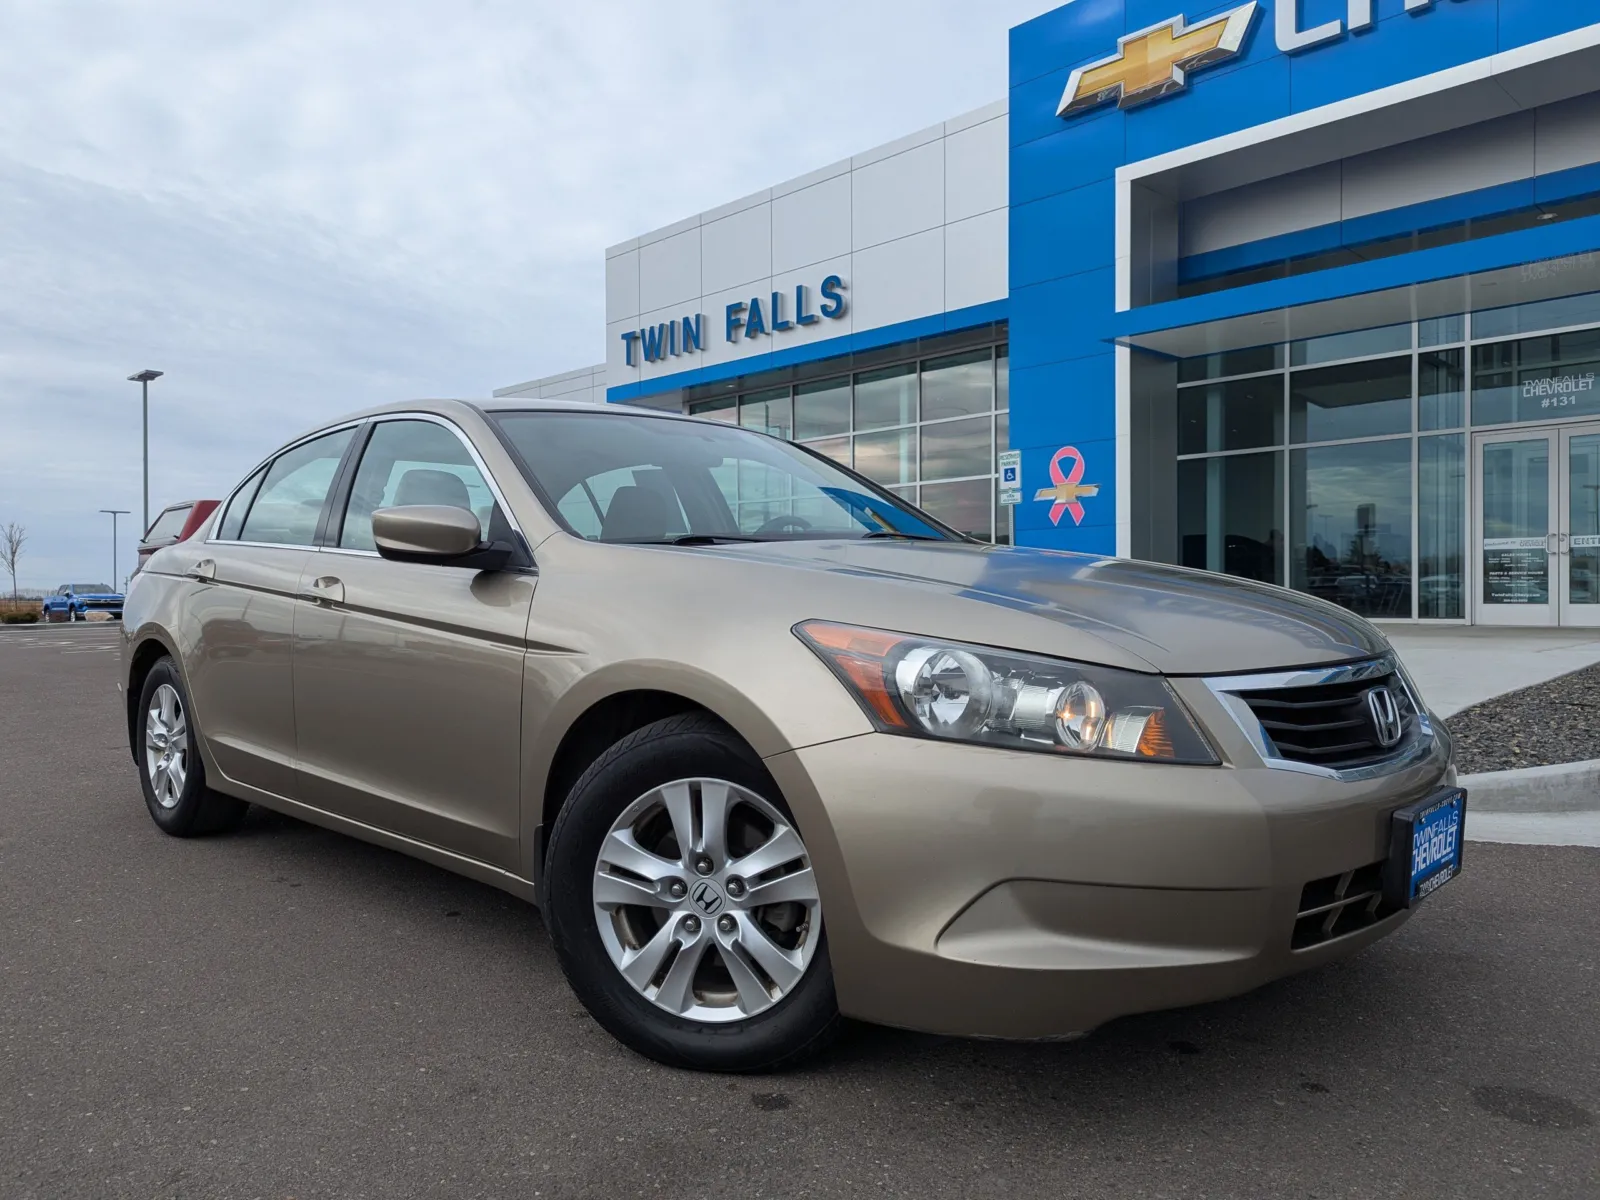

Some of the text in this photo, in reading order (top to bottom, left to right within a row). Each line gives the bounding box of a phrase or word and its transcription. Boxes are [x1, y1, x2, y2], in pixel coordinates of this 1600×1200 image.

[621, 275, 848, 367] TWIN FALLS
[1523, 379, 1594, 397] CHEVROLET
[1541, 395, 1576, 408] #131
